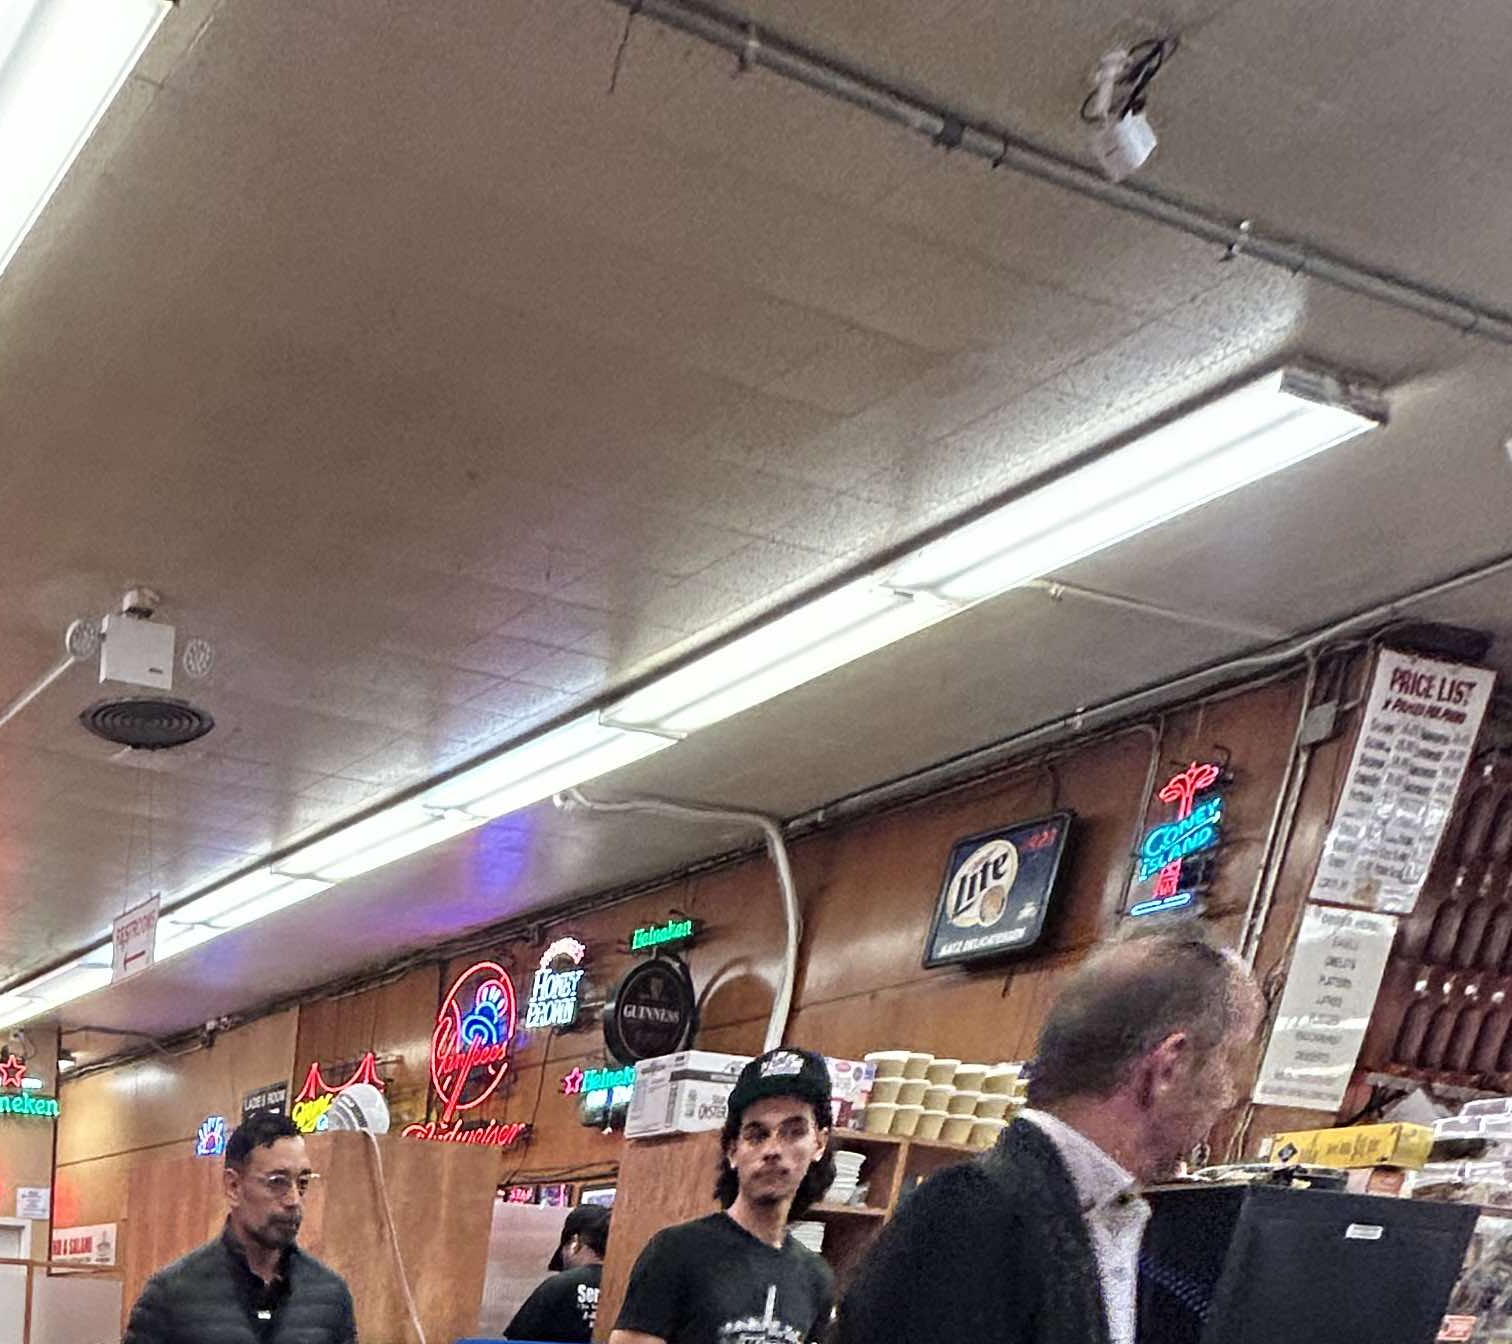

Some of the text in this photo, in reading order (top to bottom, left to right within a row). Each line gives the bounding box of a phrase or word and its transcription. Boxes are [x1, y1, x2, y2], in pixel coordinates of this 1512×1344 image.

[1390, 667, 1477, 706] PRICE LIST
[1145, 797, 1221, 858] CONEY
[951, 852, 1010, 919] Lite
[631, 919, 694, 951] Heineken
[531, 969, 585, 1000] HONEY
[622, 1003, 681, 1023] GUINNESS
